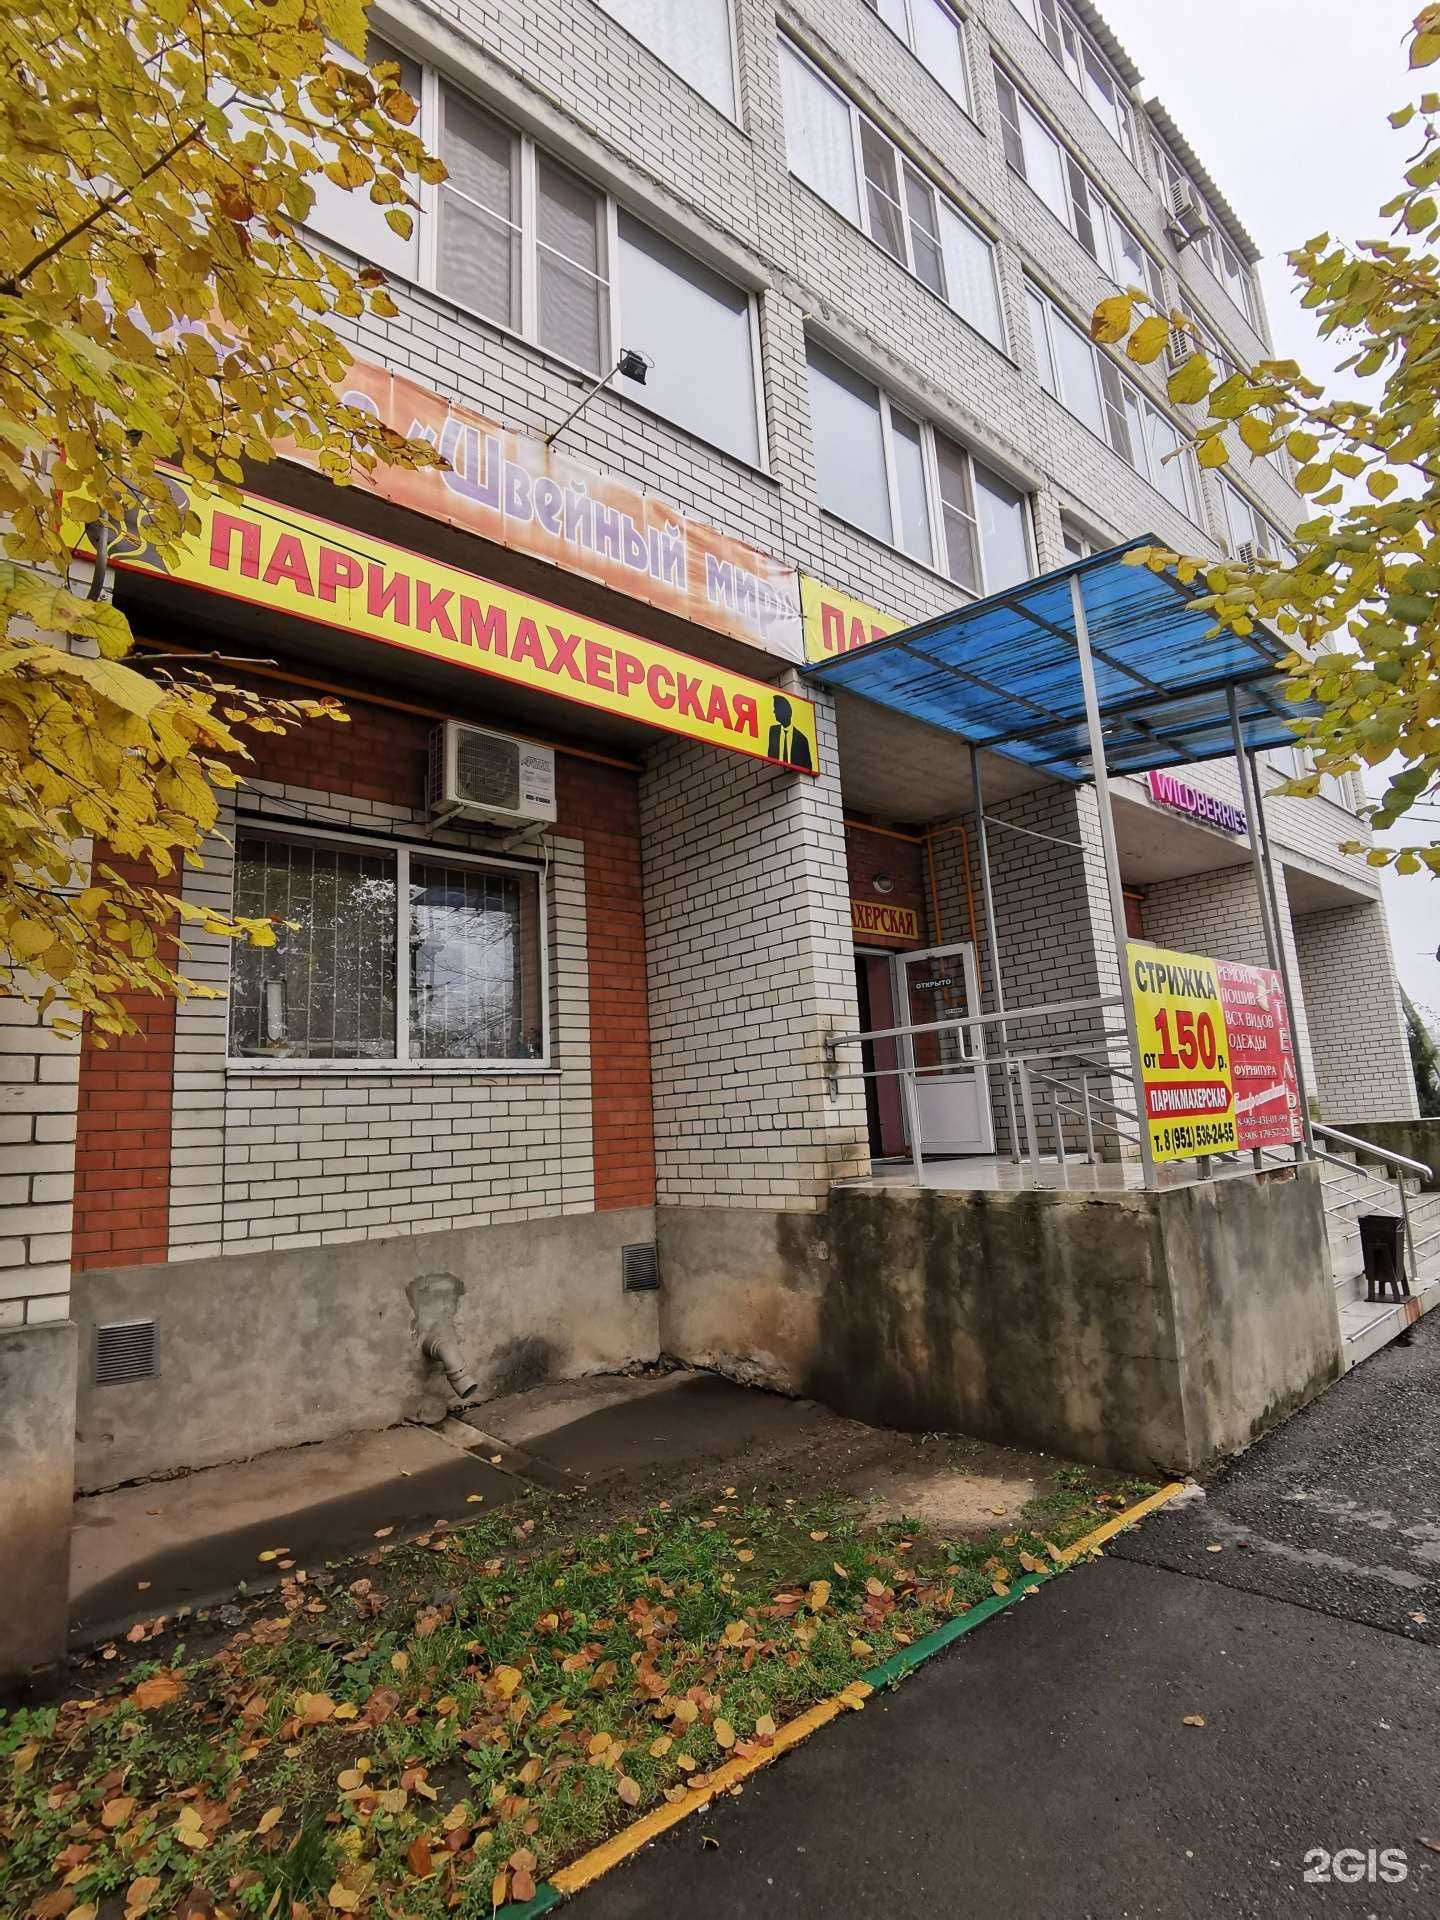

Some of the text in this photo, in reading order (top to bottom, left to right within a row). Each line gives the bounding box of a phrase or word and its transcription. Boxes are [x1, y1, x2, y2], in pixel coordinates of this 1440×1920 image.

[209, 510, 760, 738] ПАРИКМАХЕРСКАЯ
[820, 601, 889, 654] ПА
[1147, 769, 1249, 834] WILDBERRIES
[915, 978, 952, 990] ОТКРЫТО
[1135, 960, 1217, 1000] СТРИЖКА
[1221, 988, 1256, 1005] ПОШИВ
[1246, 1012, 1274, 1031] ВИДОВ
[1143, 1008, 1228, 1072] от 150 р.
[1228, 1033, 1267, 1051] ОДЕЖДЫ
[1234, 1064, 1277, 1076] ФУРНИТУРА
[1150, 1087, 1227, 1112] ПАРИКМАХЕРСКАЯ
[1154, 1122, 1235, 1154] т. 8 (951) 536-24-55
